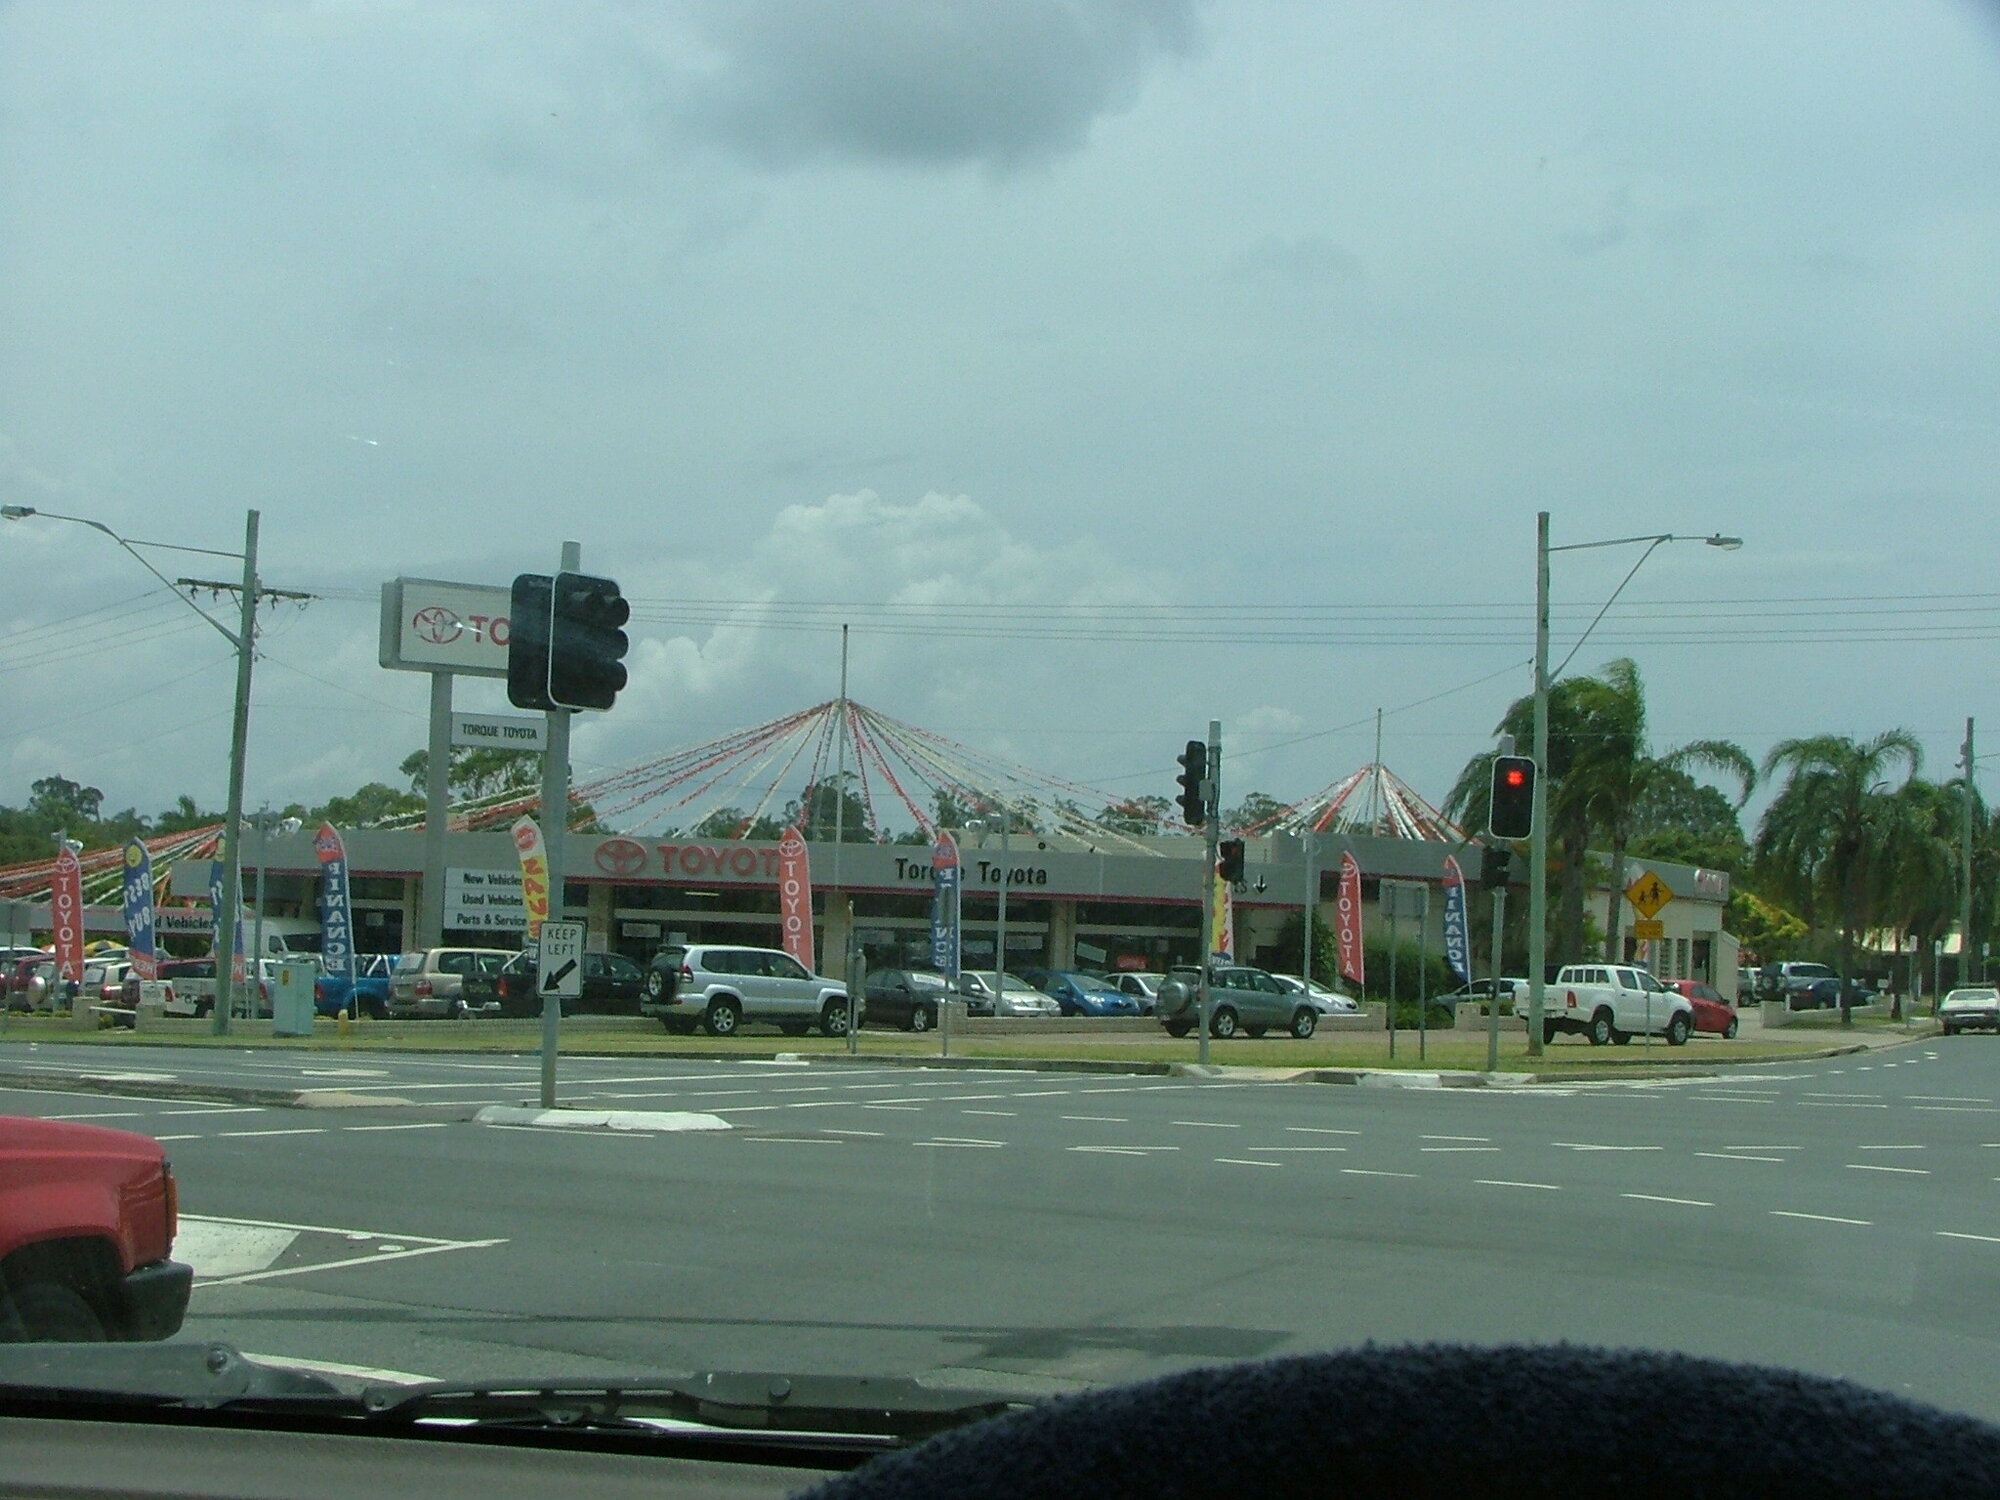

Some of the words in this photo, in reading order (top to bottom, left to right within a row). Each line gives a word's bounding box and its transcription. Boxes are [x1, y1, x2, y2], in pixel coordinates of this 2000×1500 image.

[469, 615, 510, 646] TO
[462, 723, 499, 737] TORQUE
[503, 725, 538, 740] TOYOTA
[656, 845, 779, 877] TOYOT
[895, 858, 966, 881] Tor
[463, 873, 483, 884] New
[488, 874, 523, 886] Vehicles
[462, 893, 484, 905] Used
[488, 894, 523, 906] Vehicles
[58, 877, 74, 976] TOYOTA
[166, 915, 214, 929] Vehicles
[457, 913, 479, 924] Parts
[484, 914, 492, 924] &
[495, 914, 527, 926] Service
[547, 928, 577, 940] KEEP
[1338, 882, 1354, 974] TOYOTA
[548, 943, 575, 955] LEFT
